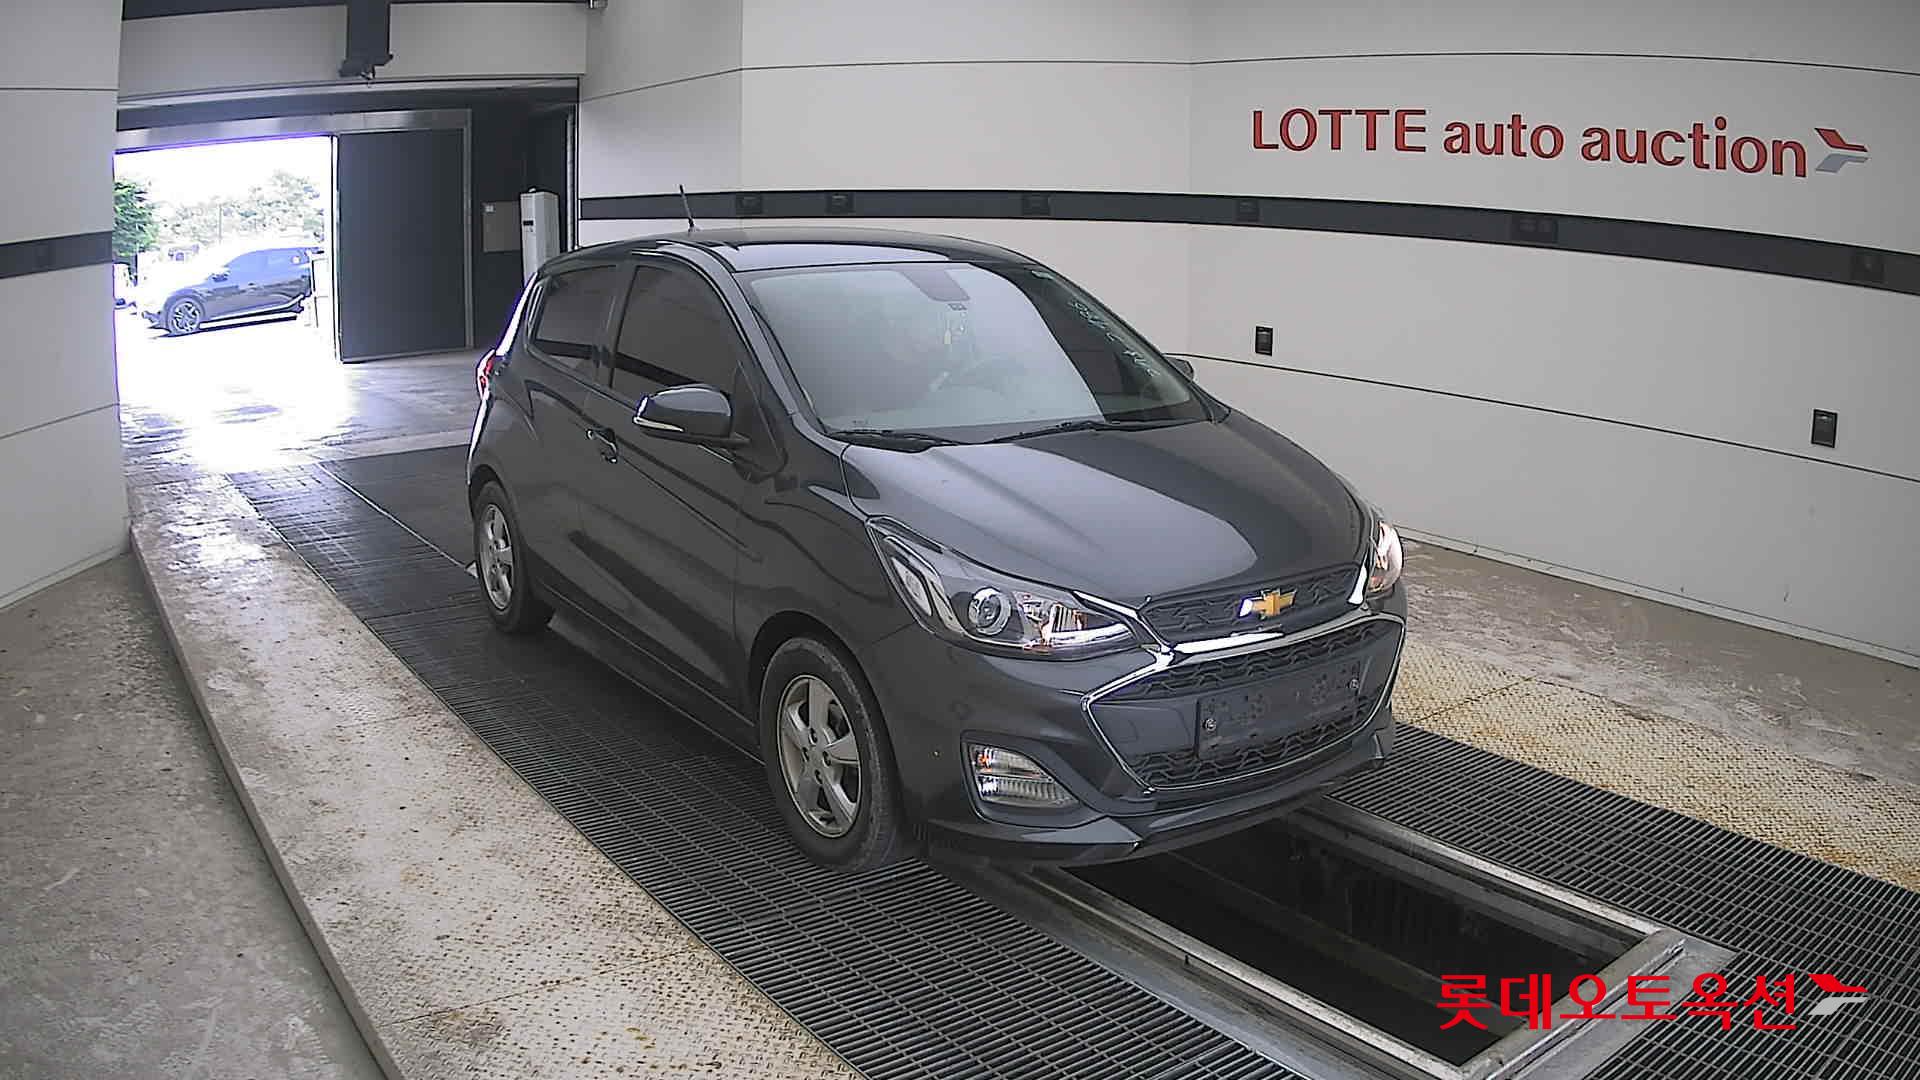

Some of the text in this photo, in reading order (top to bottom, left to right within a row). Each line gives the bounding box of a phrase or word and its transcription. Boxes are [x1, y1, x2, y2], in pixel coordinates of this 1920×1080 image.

[1252, 107, 1808, 179] LOTTE auto auction
